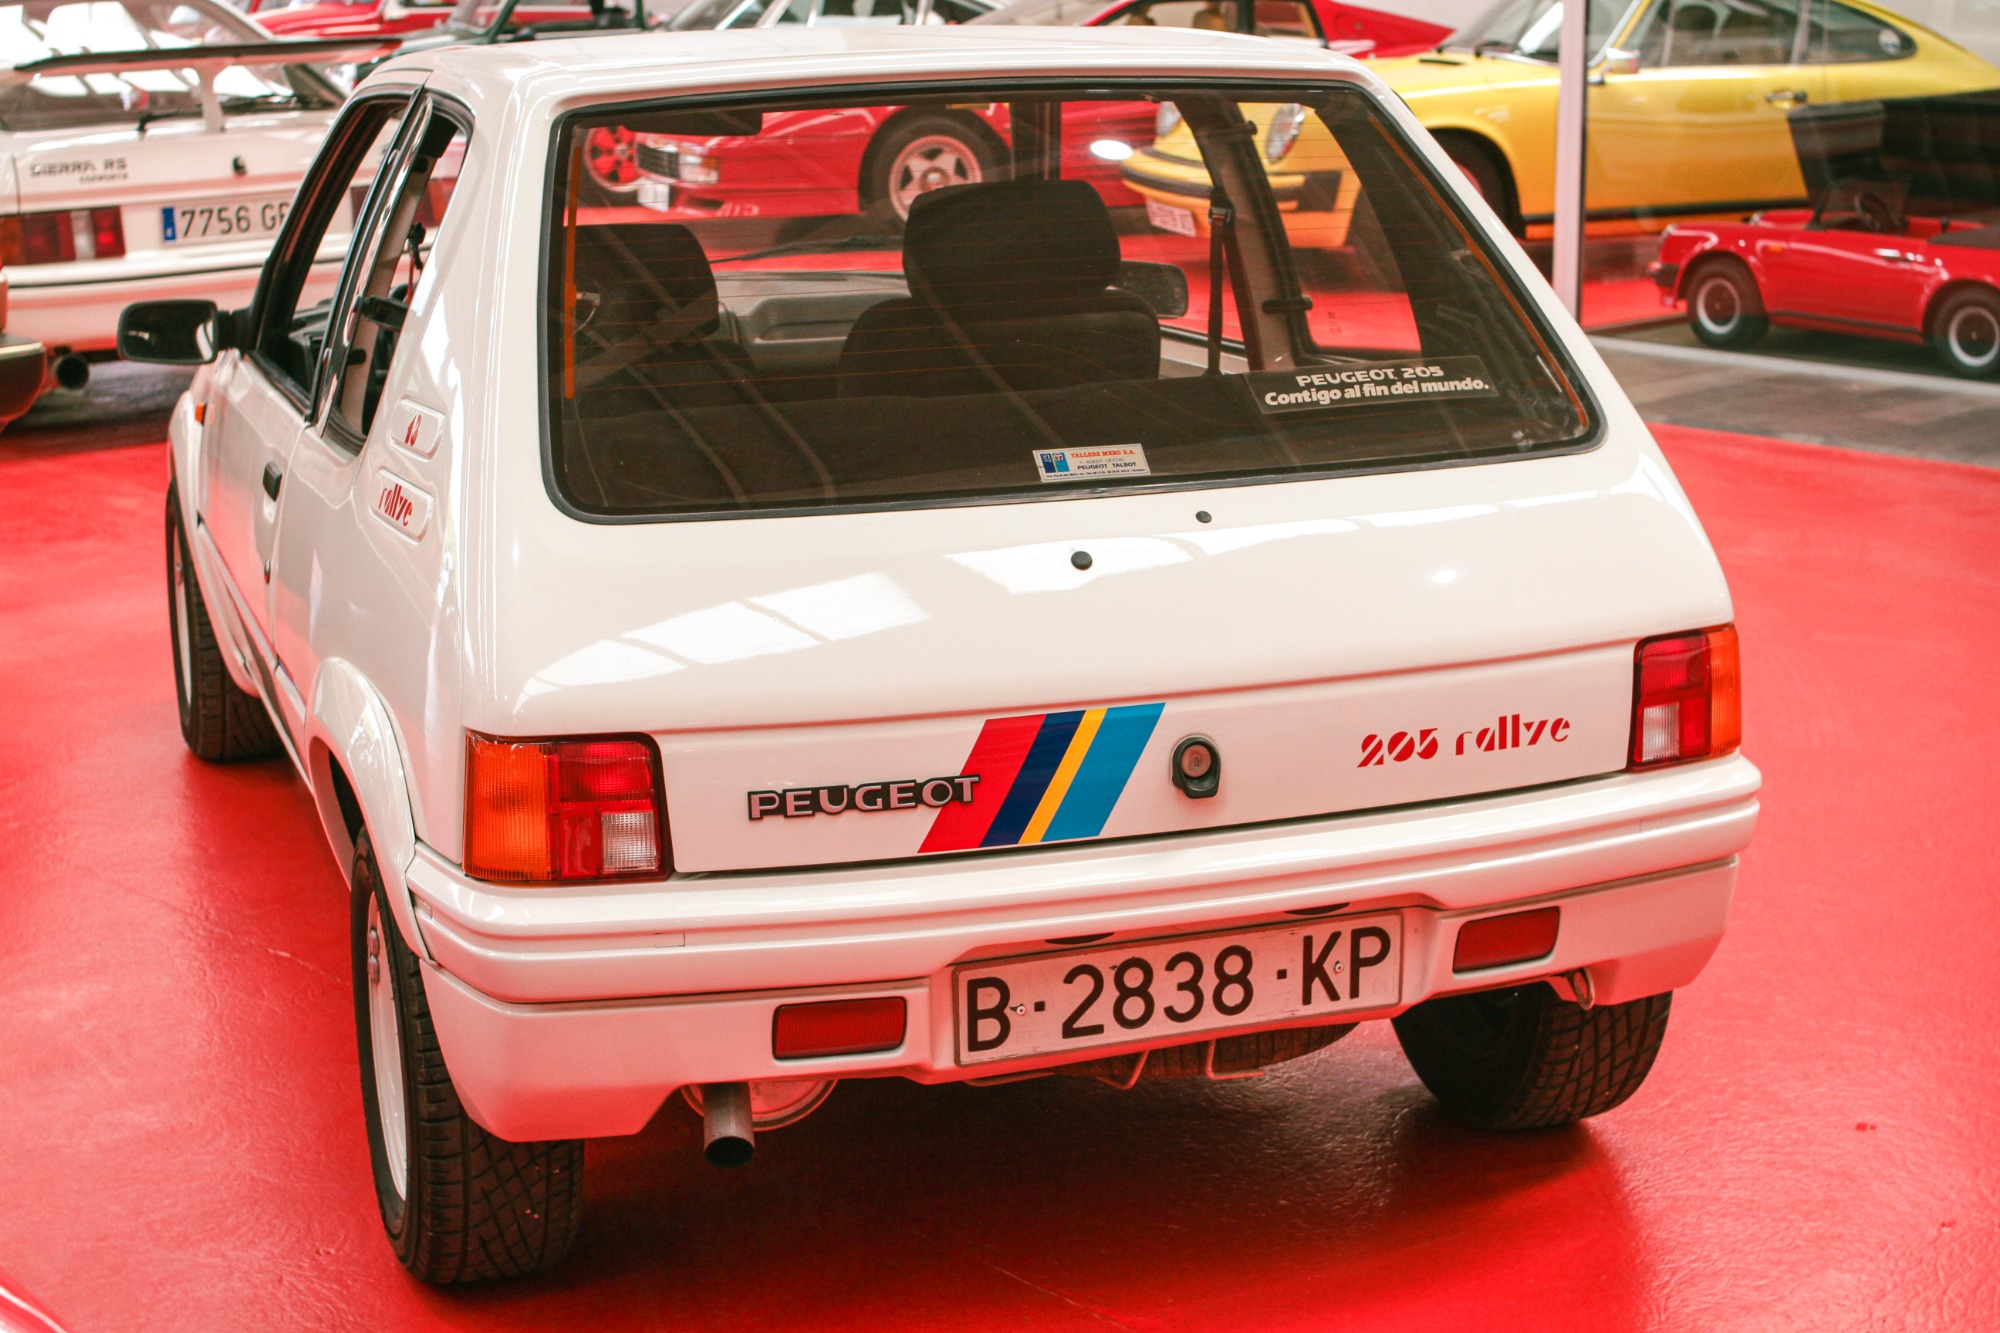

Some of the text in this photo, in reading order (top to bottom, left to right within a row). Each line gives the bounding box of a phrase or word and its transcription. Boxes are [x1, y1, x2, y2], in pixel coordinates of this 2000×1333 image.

[103, 157, 127, 170] RS
[180, 206, 251, 238] 7756
[1265, 377, 1489, 406] Contigo al fin del mundo.
[1296, 366, 1444, 387] PEUGEOT 205
[378, 483, 413, 527] rallye
[1356, 713, 1571, 768] 205 rallye
[748, 774, 981, 820] PEUGEOT
